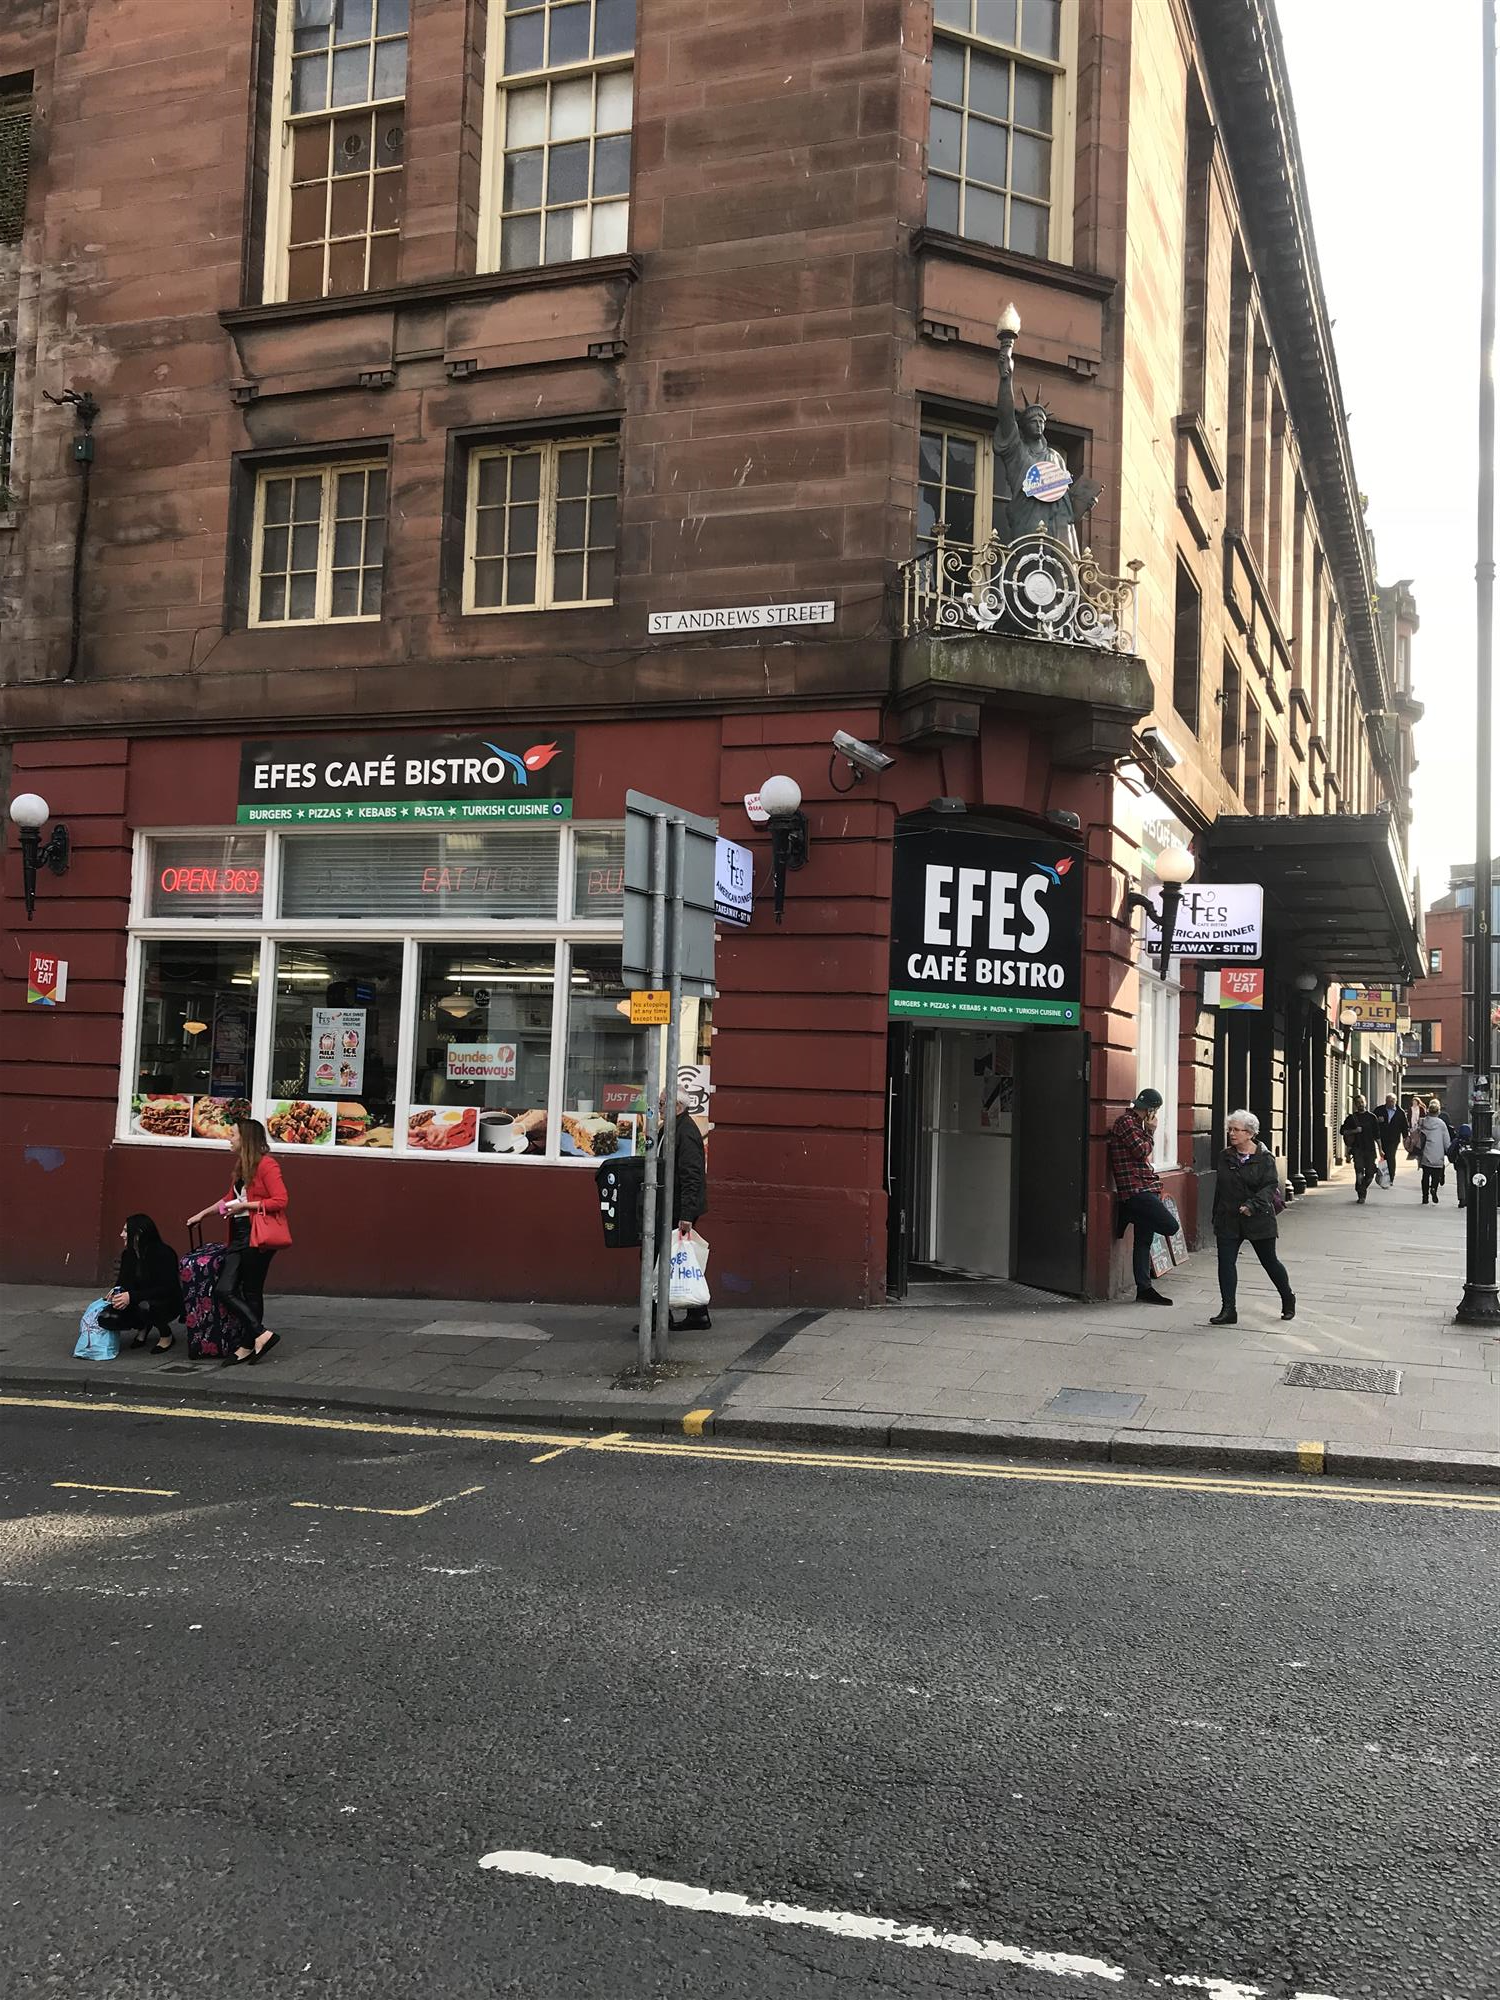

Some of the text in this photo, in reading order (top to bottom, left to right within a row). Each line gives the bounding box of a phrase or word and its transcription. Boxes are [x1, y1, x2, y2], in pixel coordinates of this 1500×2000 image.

[654, 605, 829, 630] ST ANDREWS STREET
[254, 754, 505, 789] EFES CAFÉ BISTRO
[249, 804, 549, 820] BURGERS PIZZAS KEBABS PASTA TURKISH CUISINE
[161, 868, 217, 892] OPEN
[421, 867, 467, 892] EAT
[924, 863, 1050, 954] EFES
[1180, 891, 1228, 925] EFES
[1212, 924, 1255, 939] DINNER
[1223, 944, 1240, 953] SIT
[1242, 945, 1254, 953] IN
[33, 958, 55, 972] JUST
[907, 950, 1065, 989] CAFÉ BISTRO
[37, 971, 54, 985] EAT
[1227, 972, 1258, 984] JUST
[1233, 983, 1257, 993] EAT
[894, 999, 1062, 1017] BURGERS PIZZAS KEBABS PASTA TURKISH CUISINE
[1369, 1006, 1392, 1018] LET
[449, 1051, 493, 1064] Dundee
[448, 1063, 515, 1079] Takeaways
[605, 1092, 647, 1102] JUST EAT
[669, 1252, 688, 1266] ags
